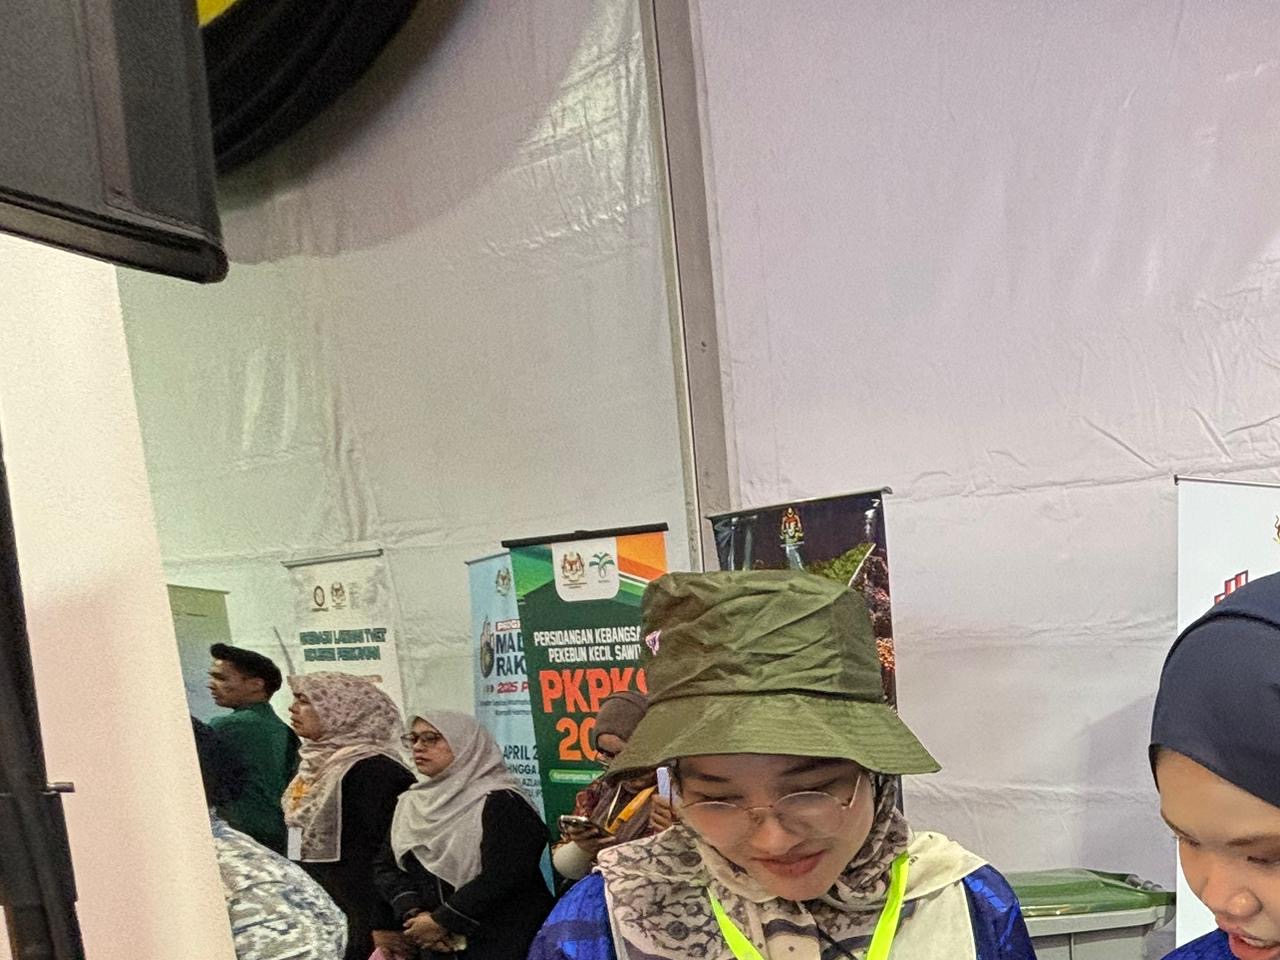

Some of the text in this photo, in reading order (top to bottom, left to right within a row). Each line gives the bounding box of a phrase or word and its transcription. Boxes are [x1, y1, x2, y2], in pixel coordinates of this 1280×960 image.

[533, 629, 594, 647] PERSIDANGAN
[548, 646, 588, 663] PEKEBUN
[588, 645, 614, 662] KECIL
[503, 744, 531, 760] APRIL
